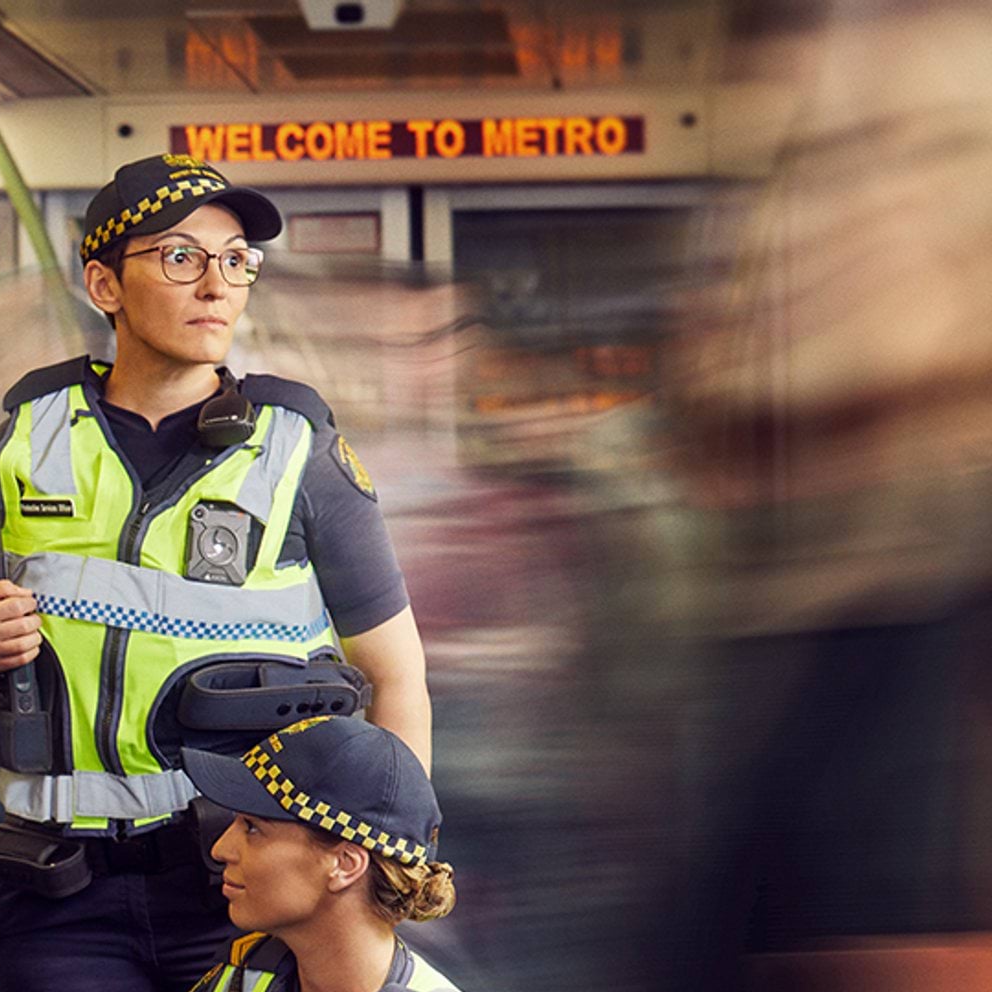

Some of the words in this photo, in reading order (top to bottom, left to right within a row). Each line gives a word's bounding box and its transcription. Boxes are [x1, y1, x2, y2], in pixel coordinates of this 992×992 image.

[185, 119, 392, 161] WELCOME
[406, 118, 465, 159] TO
[481, 115, 627, 157] METRO
